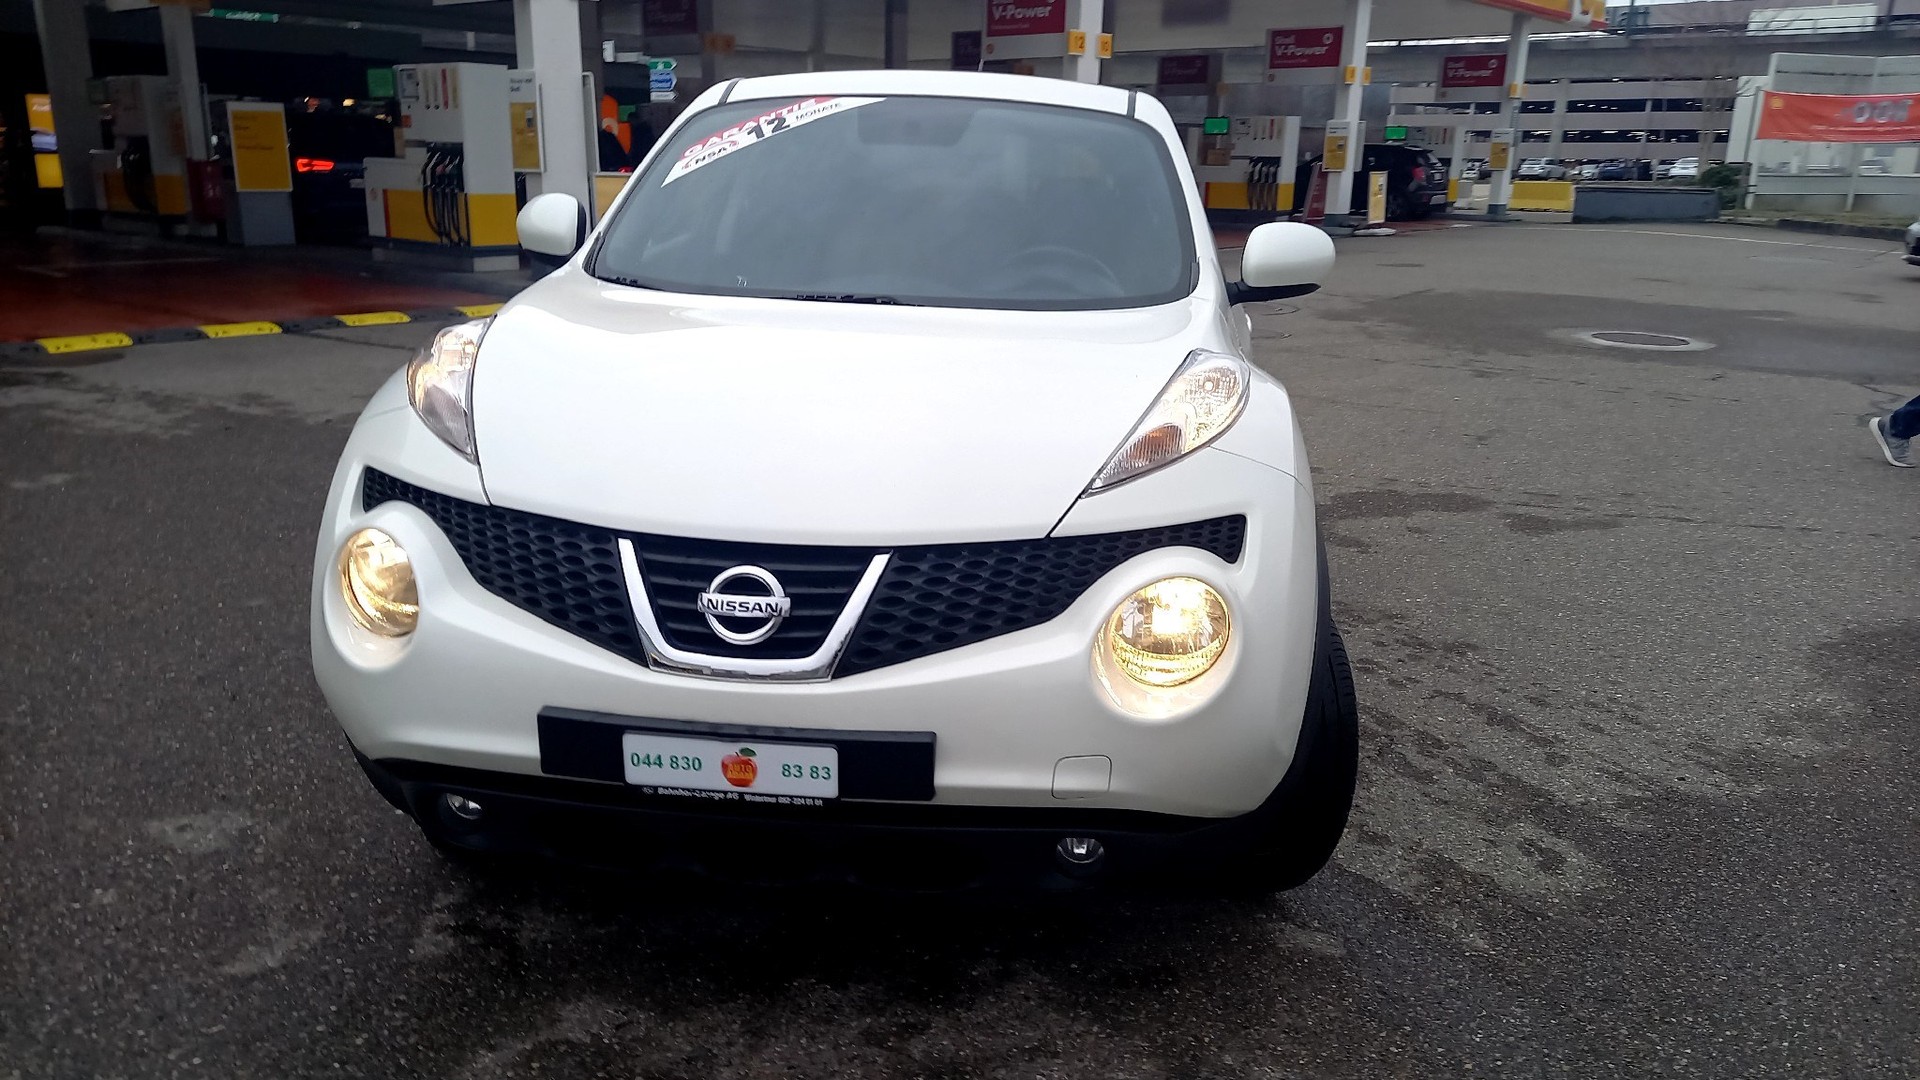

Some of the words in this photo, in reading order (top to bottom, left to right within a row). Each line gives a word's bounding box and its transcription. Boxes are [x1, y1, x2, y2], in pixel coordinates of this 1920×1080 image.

[992, 5, 1052, 21] V-Power
[1275, 45, 1329, 57] V-Power
[1447, 67, 1494, 79] V-Power
[684, 98, 818, 158] GARANTIE
[748, 117, 791, 140] 12
[706, 598, 779, 614] NISSAN
[630, 752, 664, 769] 044
[669, 755, 702, 772] 830
[781, 763, 804, 779] 83
[809, 765, 832, 780] 83
